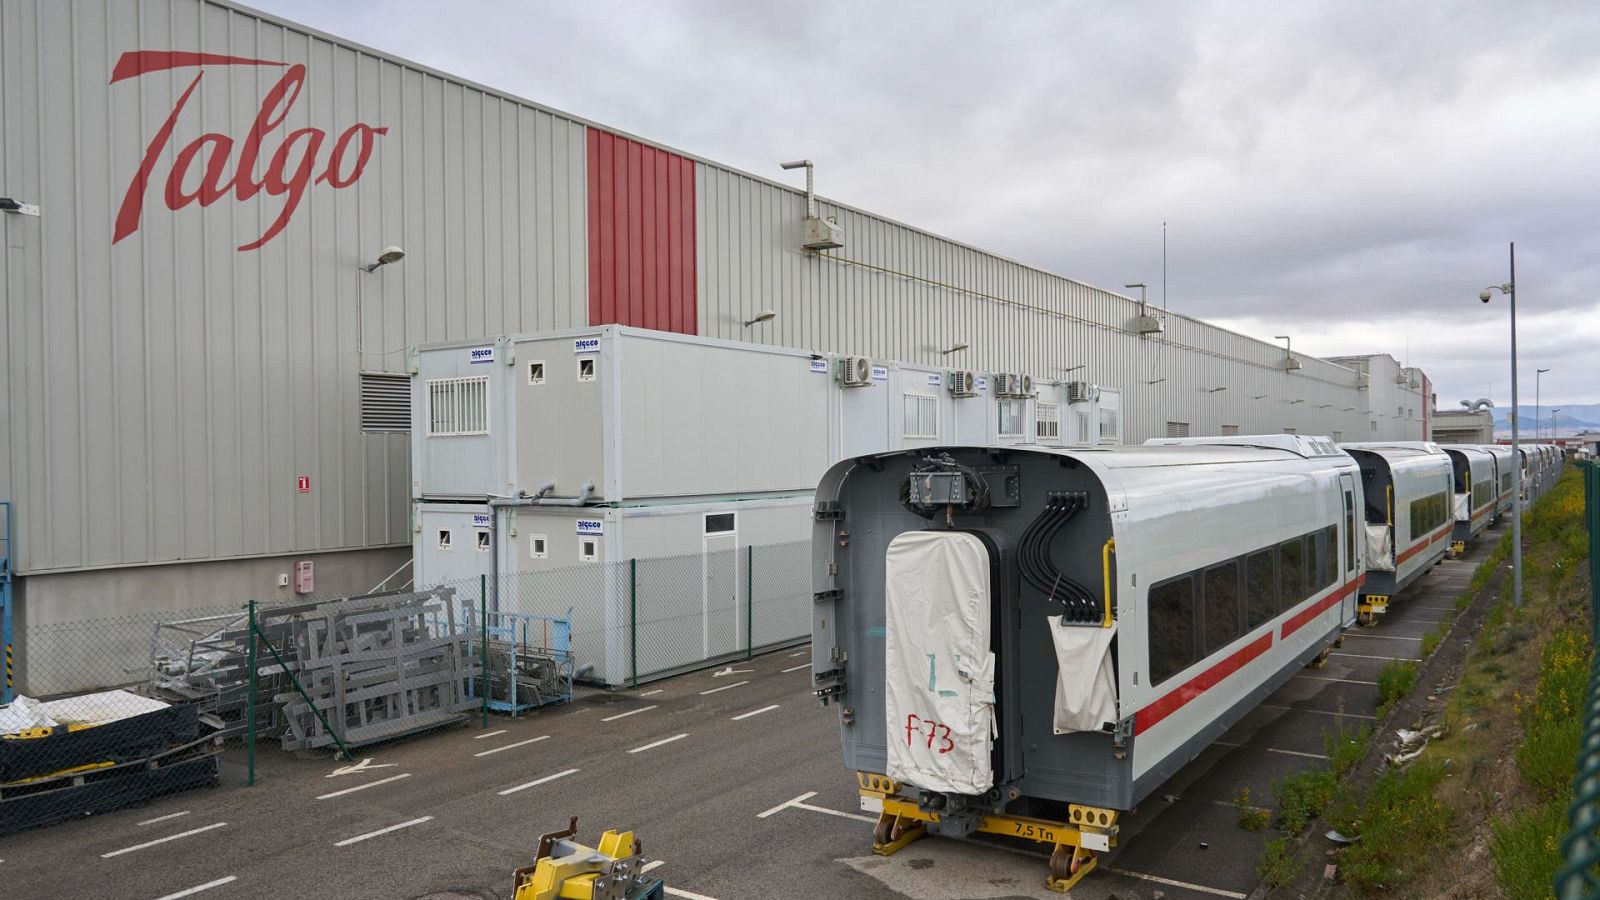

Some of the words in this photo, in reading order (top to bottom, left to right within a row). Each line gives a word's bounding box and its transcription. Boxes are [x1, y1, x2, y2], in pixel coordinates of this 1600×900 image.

[109, 50, 388, 251] Talgo
[1014, 822, 1034, 836] 7,5
[1038, 827, 1054, 840] Tn
